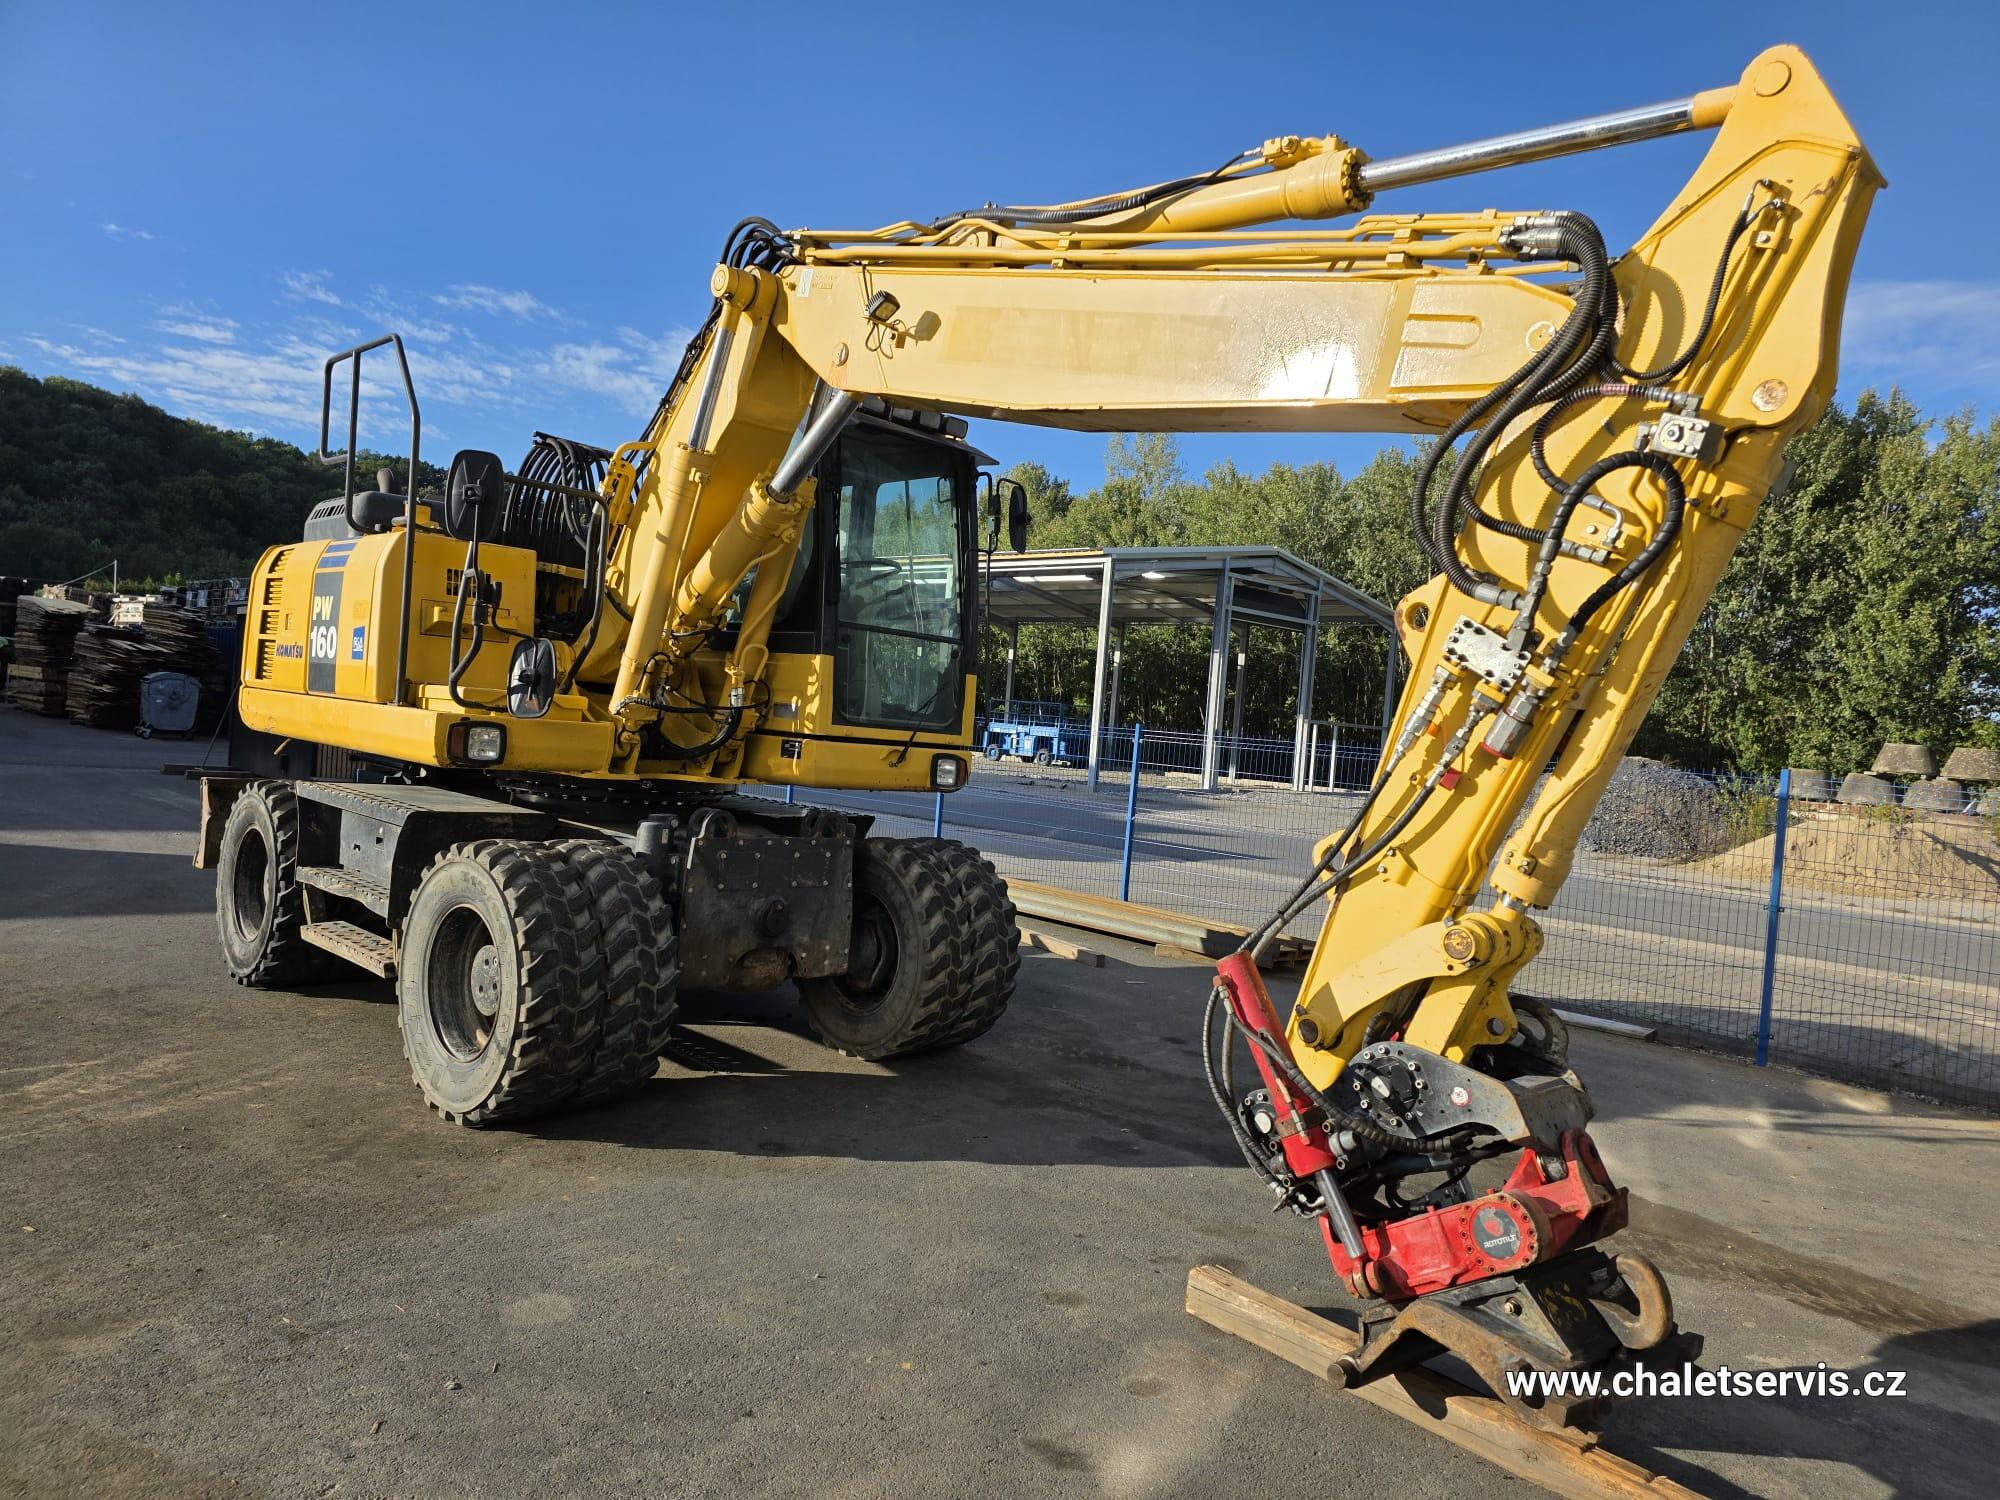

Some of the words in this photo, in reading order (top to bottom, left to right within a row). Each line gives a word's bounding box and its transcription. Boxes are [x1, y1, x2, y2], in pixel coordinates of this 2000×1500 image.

[312, 595, 334, 620] PW
[275, 641, 304, 658] KOMATSU
[310, 625, 338, 658] 160
